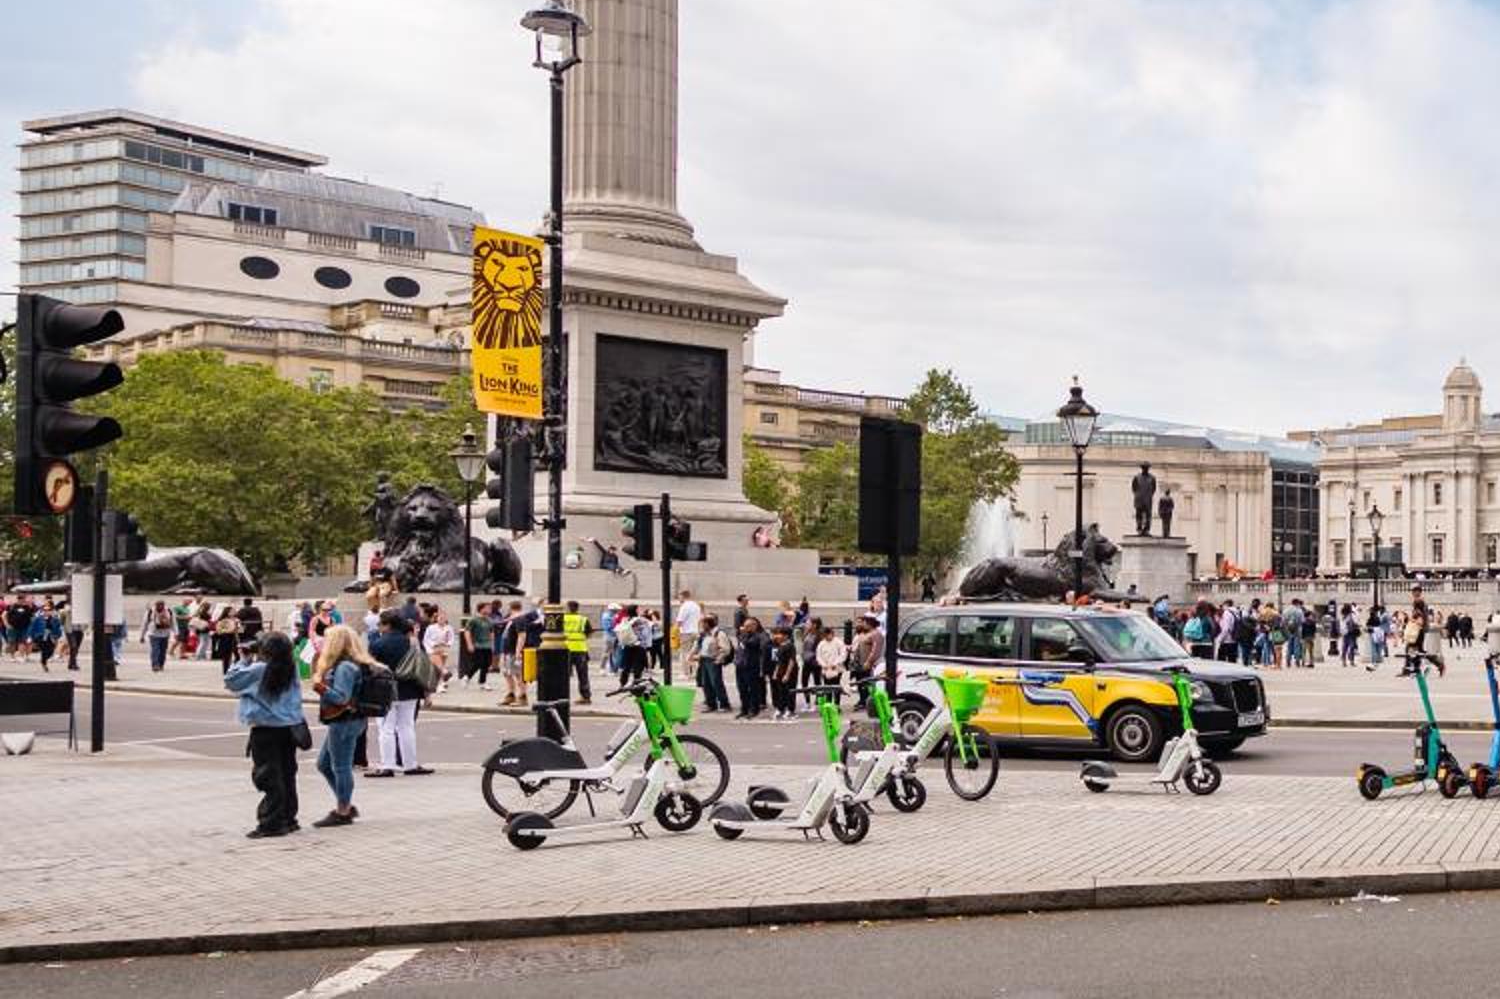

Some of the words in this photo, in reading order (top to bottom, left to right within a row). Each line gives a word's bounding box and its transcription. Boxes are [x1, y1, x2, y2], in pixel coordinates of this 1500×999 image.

[502, 363, 518, 373] THE
[480, 373, 507, 391] LION
[510, 377, 538, 396] KING
